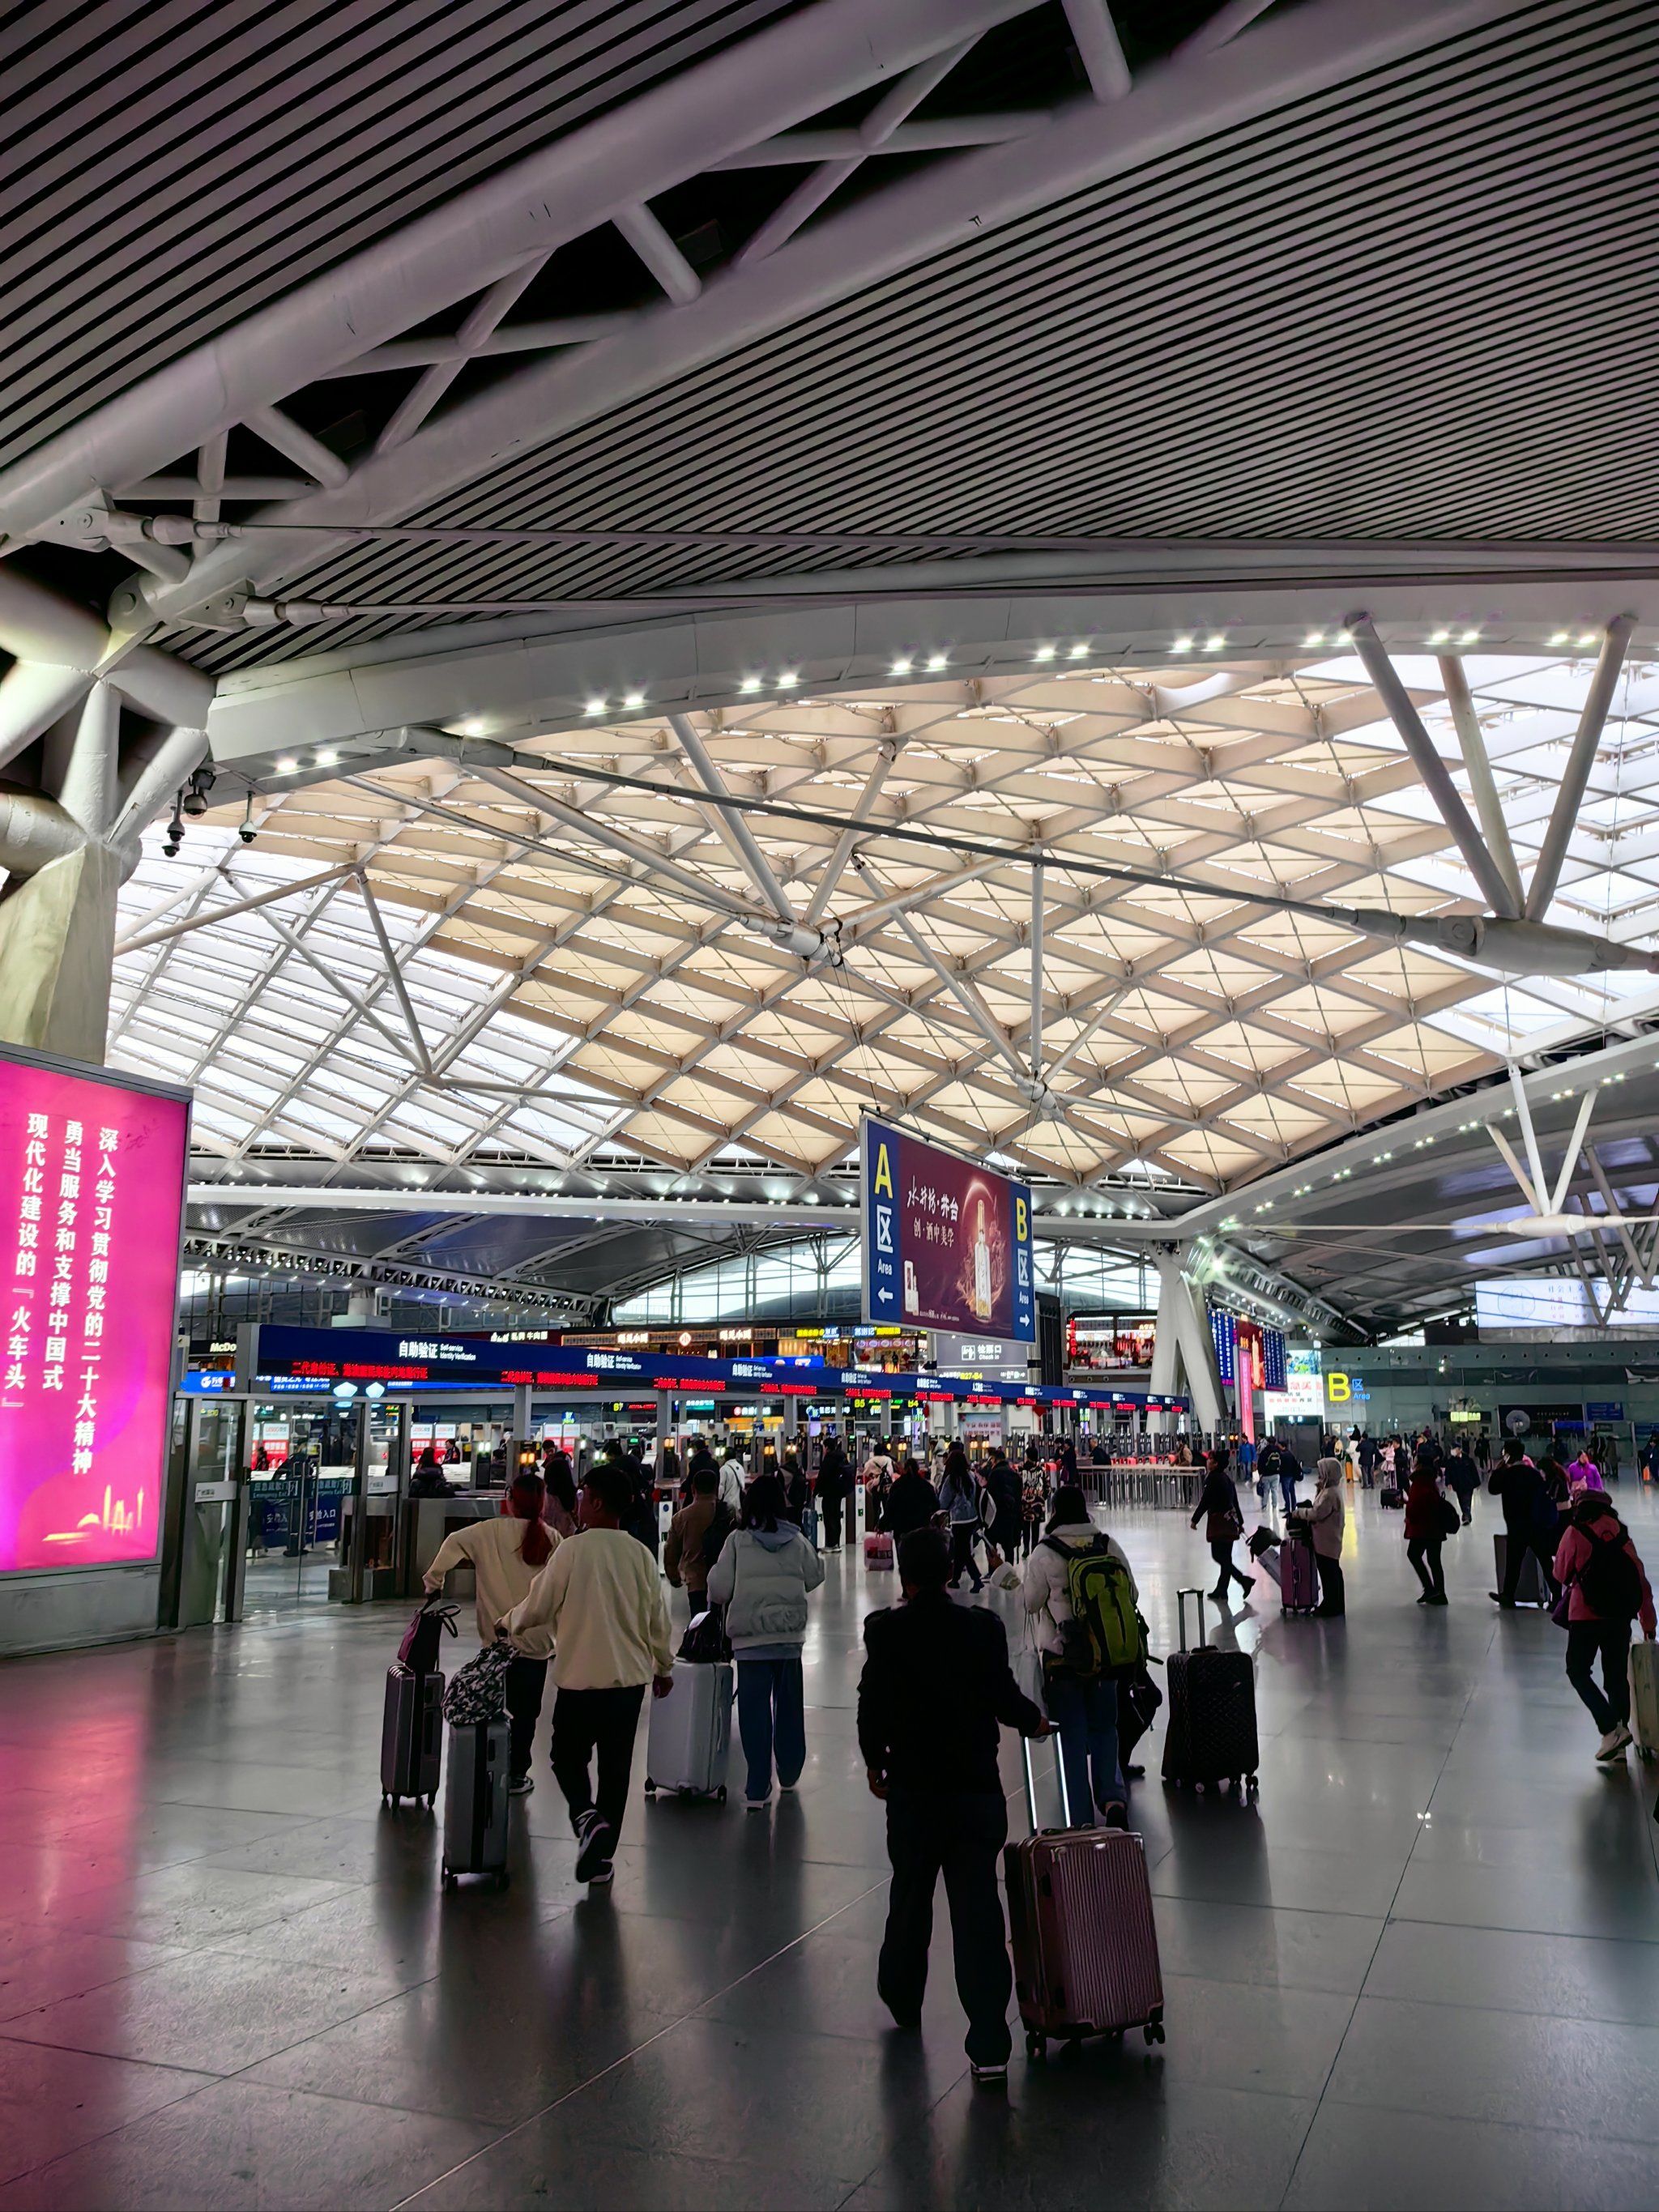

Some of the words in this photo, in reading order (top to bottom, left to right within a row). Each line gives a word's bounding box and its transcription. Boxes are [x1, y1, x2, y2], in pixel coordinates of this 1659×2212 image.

[874, 1143, 893, 1199] A
[876, 1204, 893, 1253] 区
[914, 1217, 954, 1247] 创·酒中美学
[1016, 1197, 1028, 1242] B
[42, 1119, 83, 1391] 勇当服务和支撑中国式
[877, 1258, 893, 1275] Area
[1017, 1248, 1030, 1286] 区
[72, 1127, 118, 1475] 深入学习贯彻党的二十大精神
[1019, 1291, 1029, 1305] Area
[399, 1340, 438, 1359] 自助验证
[586, 1353, 615, 1369] 自助验证
[1328, 1373, 1351, 1401] B
[1352, 1379, 1364, 1392] 区
[1354, 1392, 1371, 1400] Area
